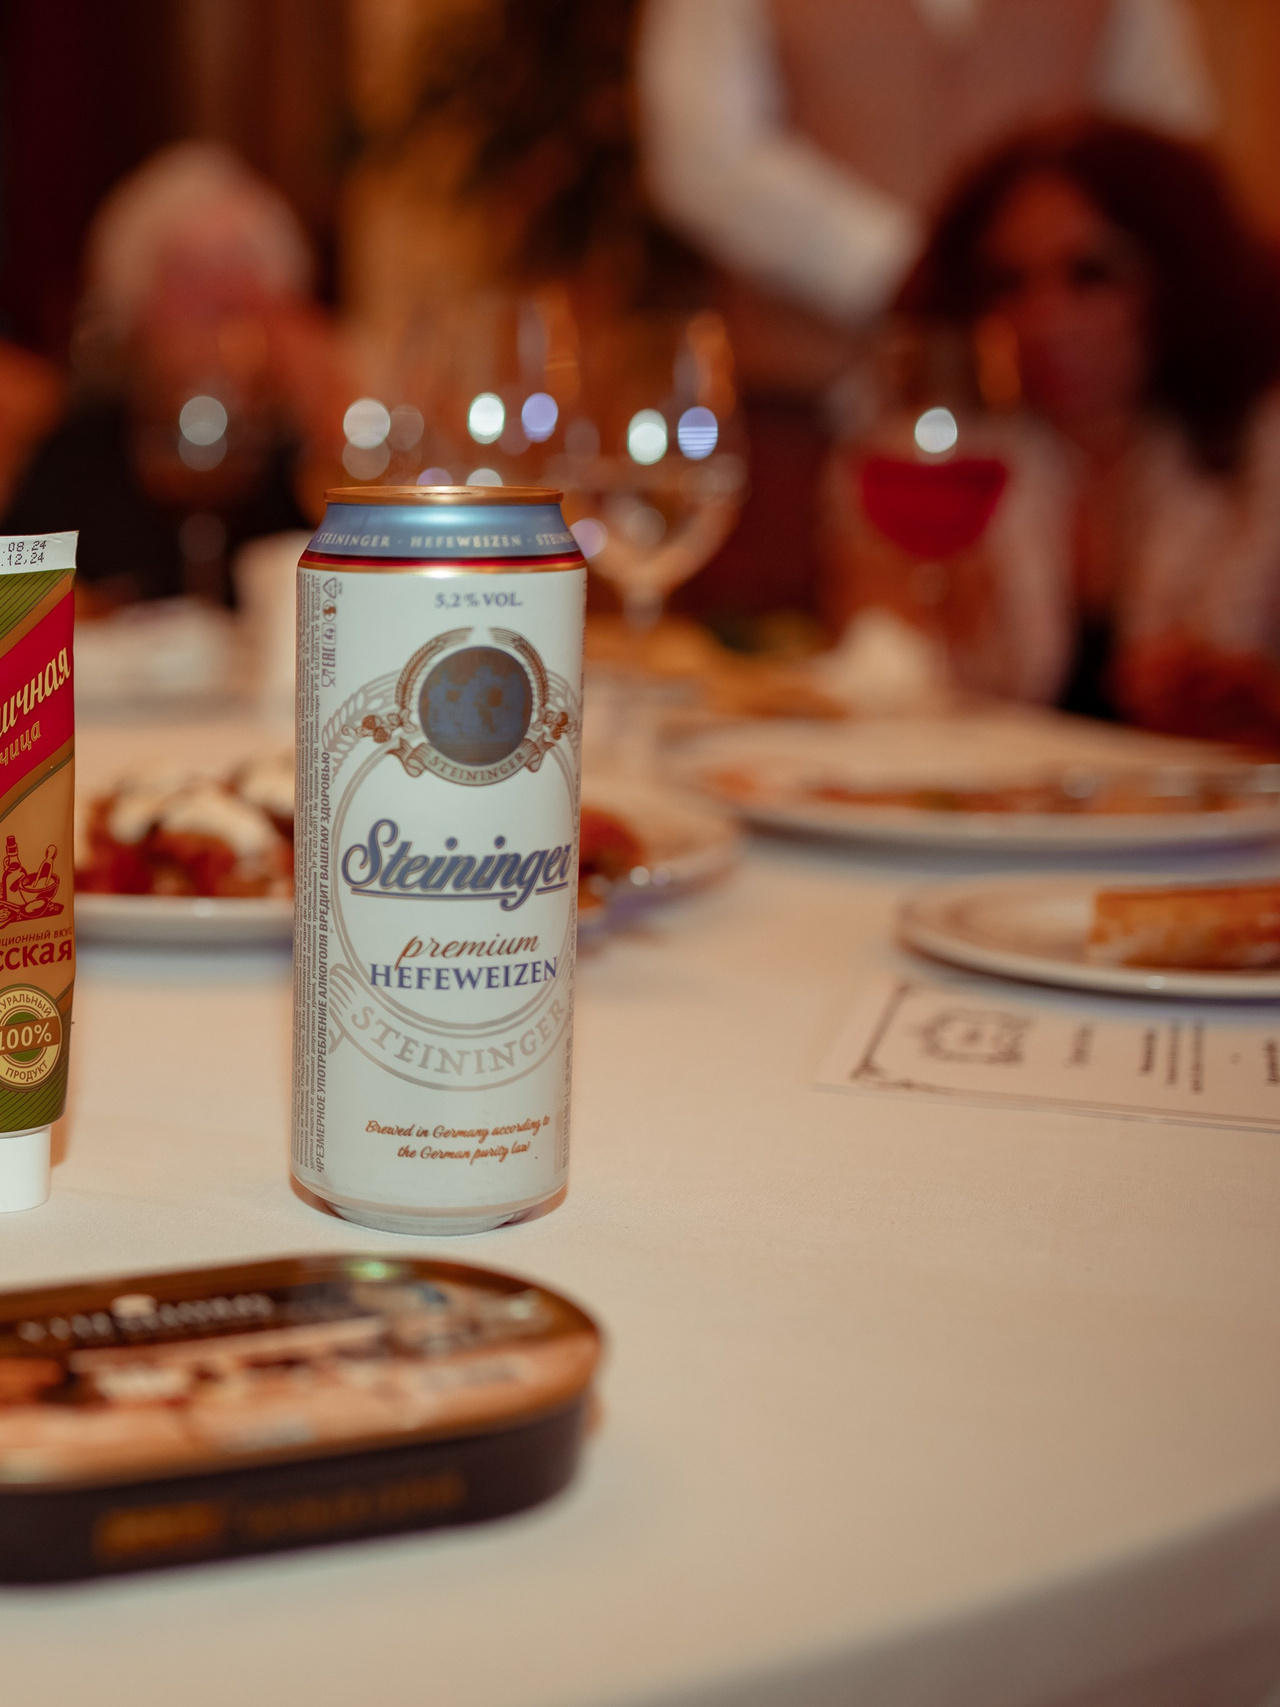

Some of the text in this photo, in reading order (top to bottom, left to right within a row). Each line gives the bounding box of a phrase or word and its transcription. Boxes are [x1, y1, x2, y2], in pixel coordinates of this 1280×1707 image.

[317, 532, 522, 549] STEININGER HEFEWEIZEN
[482, 592, 524, 607] VOL.
[428, 753, 525, 781] STEININGER
[341, 818, 572, 911] Steininger
[316, 752, 330, 1173] ЧРЕЗМЕРНОЕ УПОТРЕБЛЕНИЕ АЛКОГОЛЯ ВРЕДИТ ВАШЕМУ ЗДОРОВЬЮ
[395, 933, 540, 970] premium
[369, 957, 558, 990] HEFEWEIZEN
[351, 999, 566, 1077] STEININGER
[5, 1060, 48, 1082] ПРОДУКТ
[365, 1115, 550, 1144] Brewed in Germany according to
[397, 1141, 531, 1166] the German purity law
